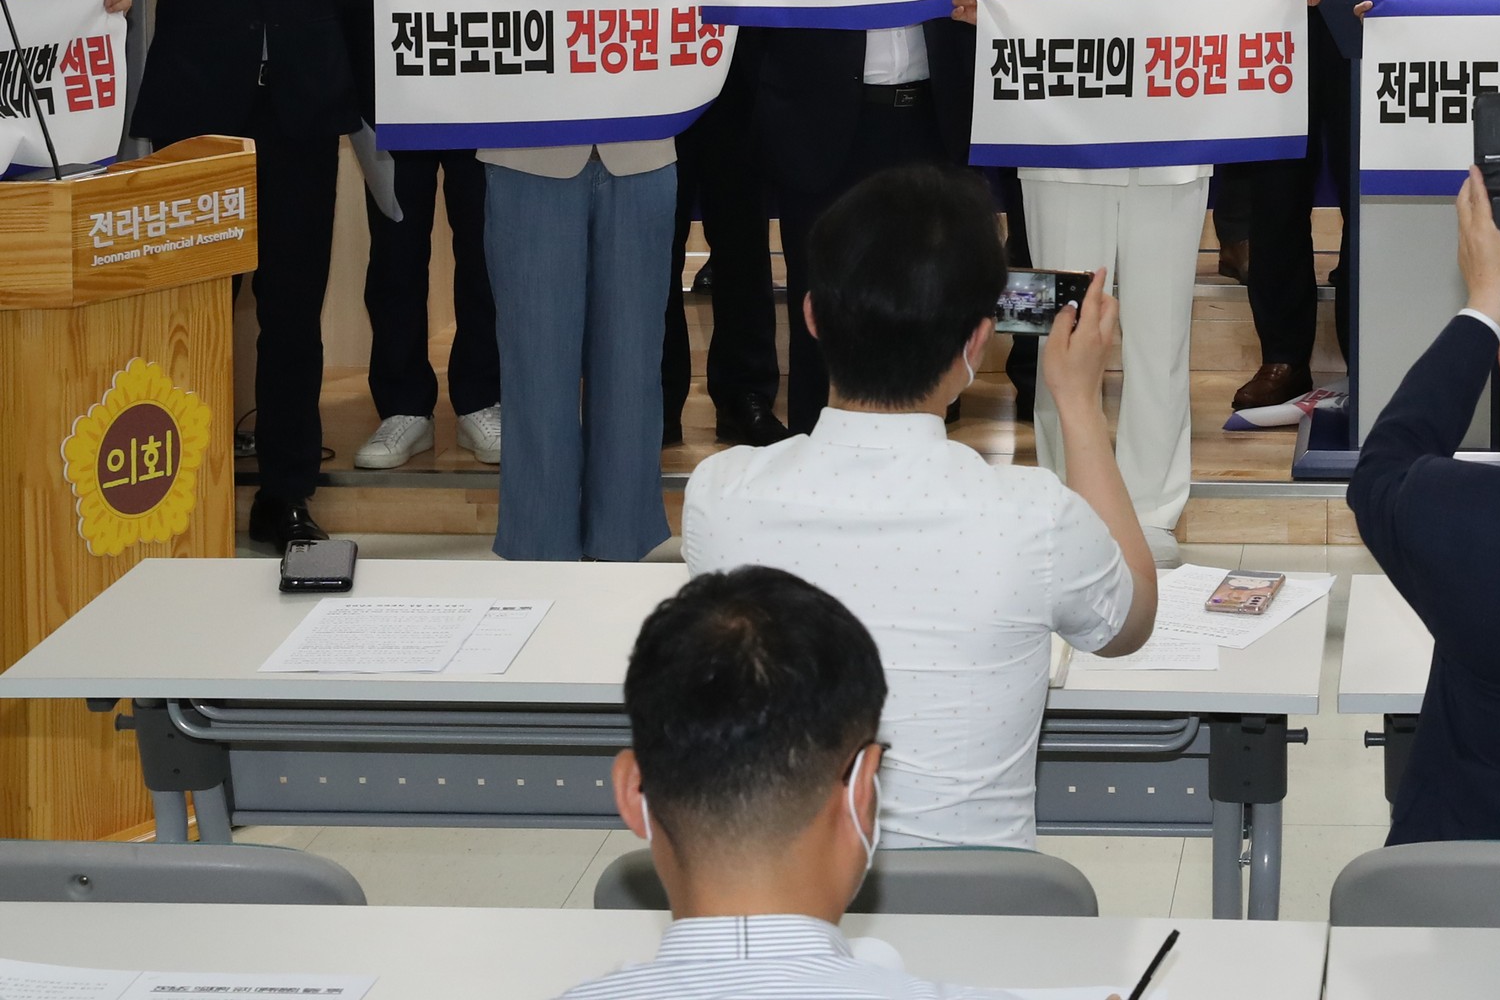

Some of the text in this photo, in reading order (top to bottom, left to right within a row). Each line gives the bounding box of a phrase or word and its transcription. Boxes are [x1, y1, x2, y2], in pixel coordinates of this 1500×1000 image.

[59, 34, 115, 112] 설립
[391, 5, 725, 77] 전남도민의 건강권 보장
[991, 31, 1295, 100] 전남도민의 건강권 보장
[88, 186, 246, 249] 전라남도의회
[91, 226, 245, 267] Jeonnam Provincial Assembly
[102, 429, 173, 490] 의회
